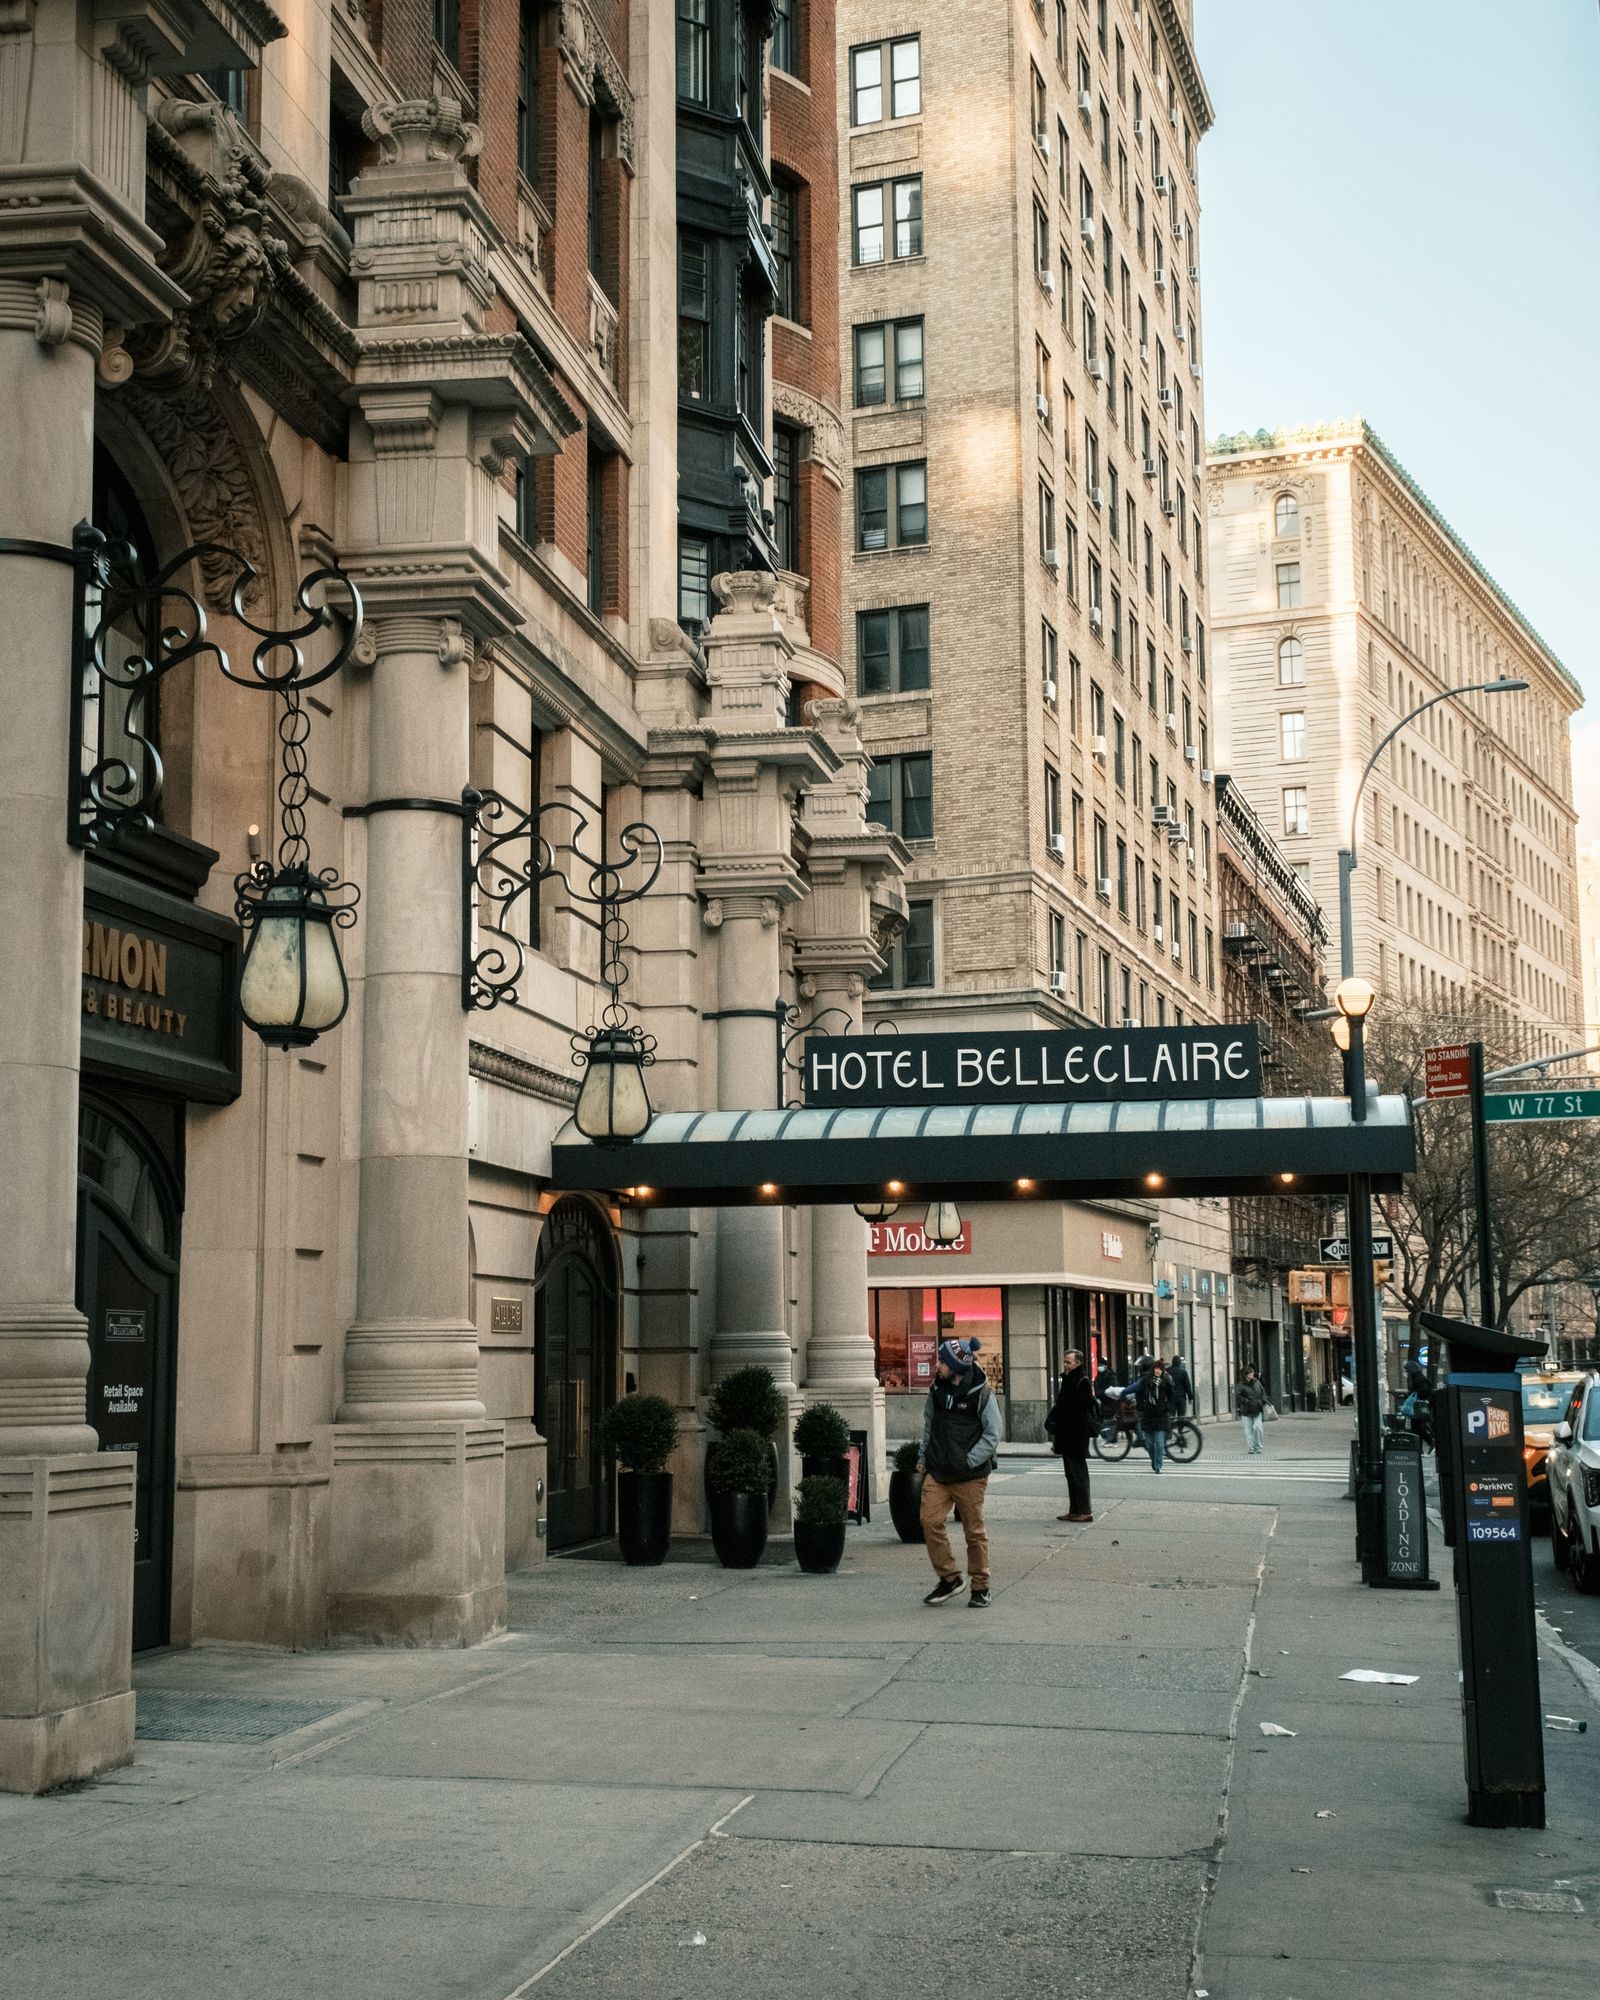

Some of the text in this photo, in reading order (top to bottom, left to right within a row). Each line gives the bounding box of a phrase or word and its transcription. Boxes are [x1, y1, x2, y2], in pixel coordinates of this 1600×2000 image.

[87, 987, 187, 1037] & BEAUTY
[1427, 1052, 1437, 1062] NO
[812, 1041, 1250, 1091] HOTEL BELLECLAIRE
[1427, 1063, 1442, 1073] Hotel
[1427, 1071, 1462, 1083] Loading Zone
[1508, 1095, 1583, 1115] W 77 St
[1371, 1243, 1384, 1253] AY
[103, 1384, 144, 1402] Retail Space
[108, 1399, 138, 1413] Available
[1488, 1407, 1508, 1421] PARK
[1467, 1410, 1485, 1434] P
[1488, 1420, 1509, 1437] NYC
[1478, 1482, 1514, 1491] ParkNYC
[1397, 1472, 1410, 1559] LOADING
[1472, 1527, 1516, 1539] 109564
[1390, 1561, 1419, 1573] ZONE
